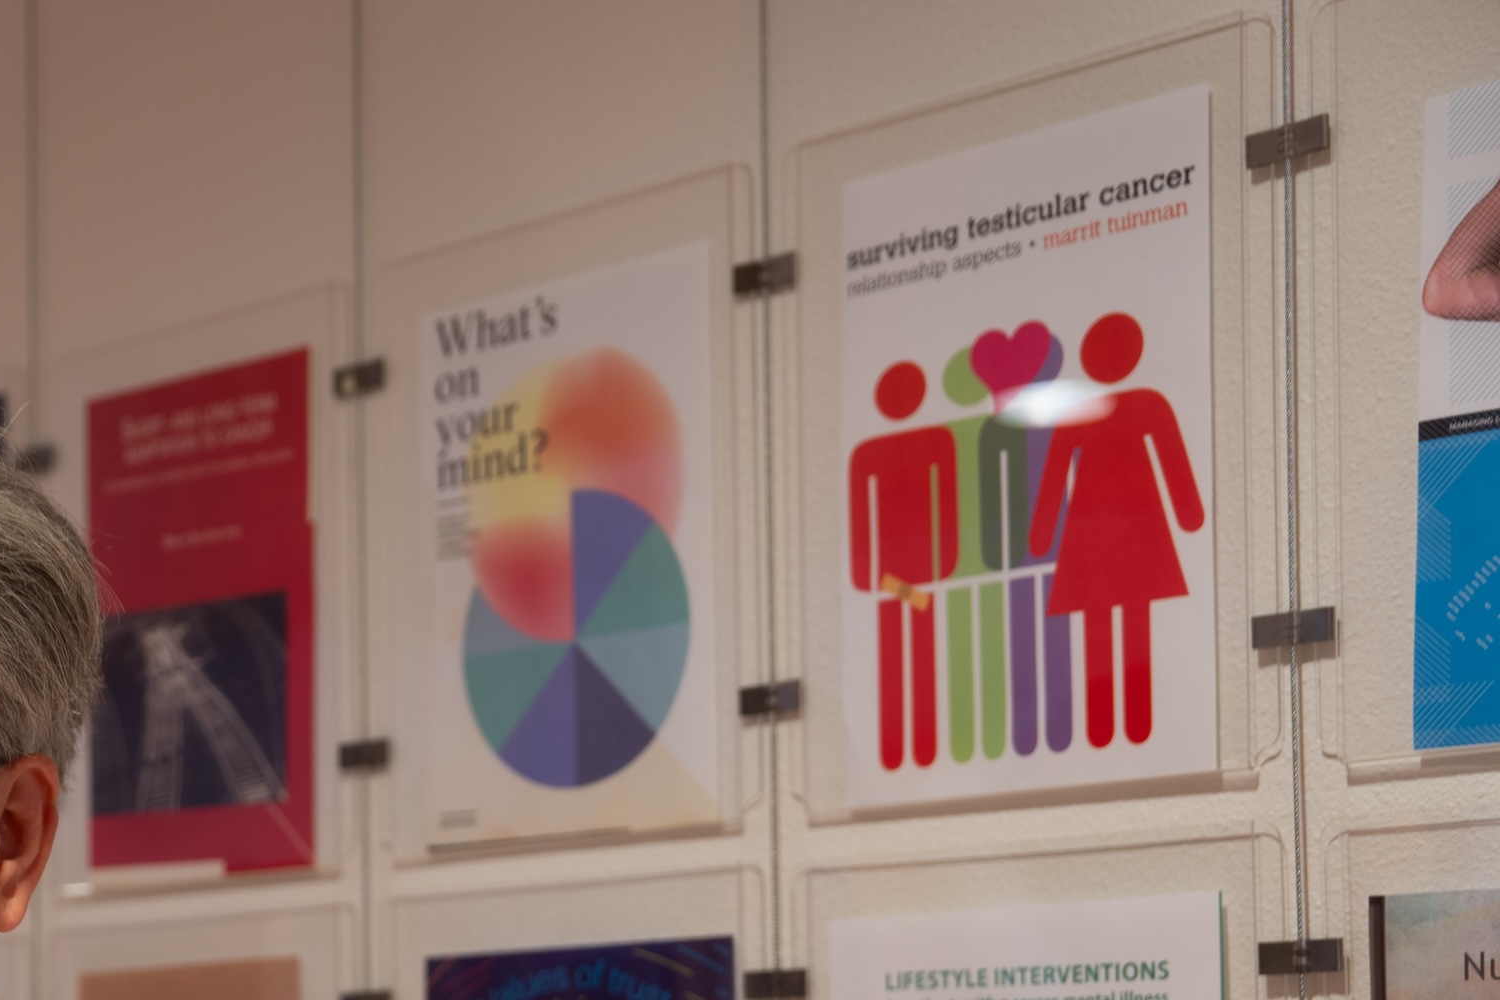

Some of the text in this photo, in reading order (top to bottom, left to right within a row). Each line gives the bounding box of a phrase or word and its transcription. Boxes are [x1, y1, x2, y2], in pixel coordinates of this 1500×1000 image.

[846, 163, 1195, 271] surviving testicular cancer
[846, 200, 1189, 299] relationship aspects marrit tuinman
[435, 294, 559, 357] What's
[434, 366, 480, 404] on
[435, 401, 520, 459] your
[436, 427, 549, 491] mind?
[574, 957, 606, 990] of
[885, 960, 1169, 992] LIFESTYLE INTERVENTIONS
